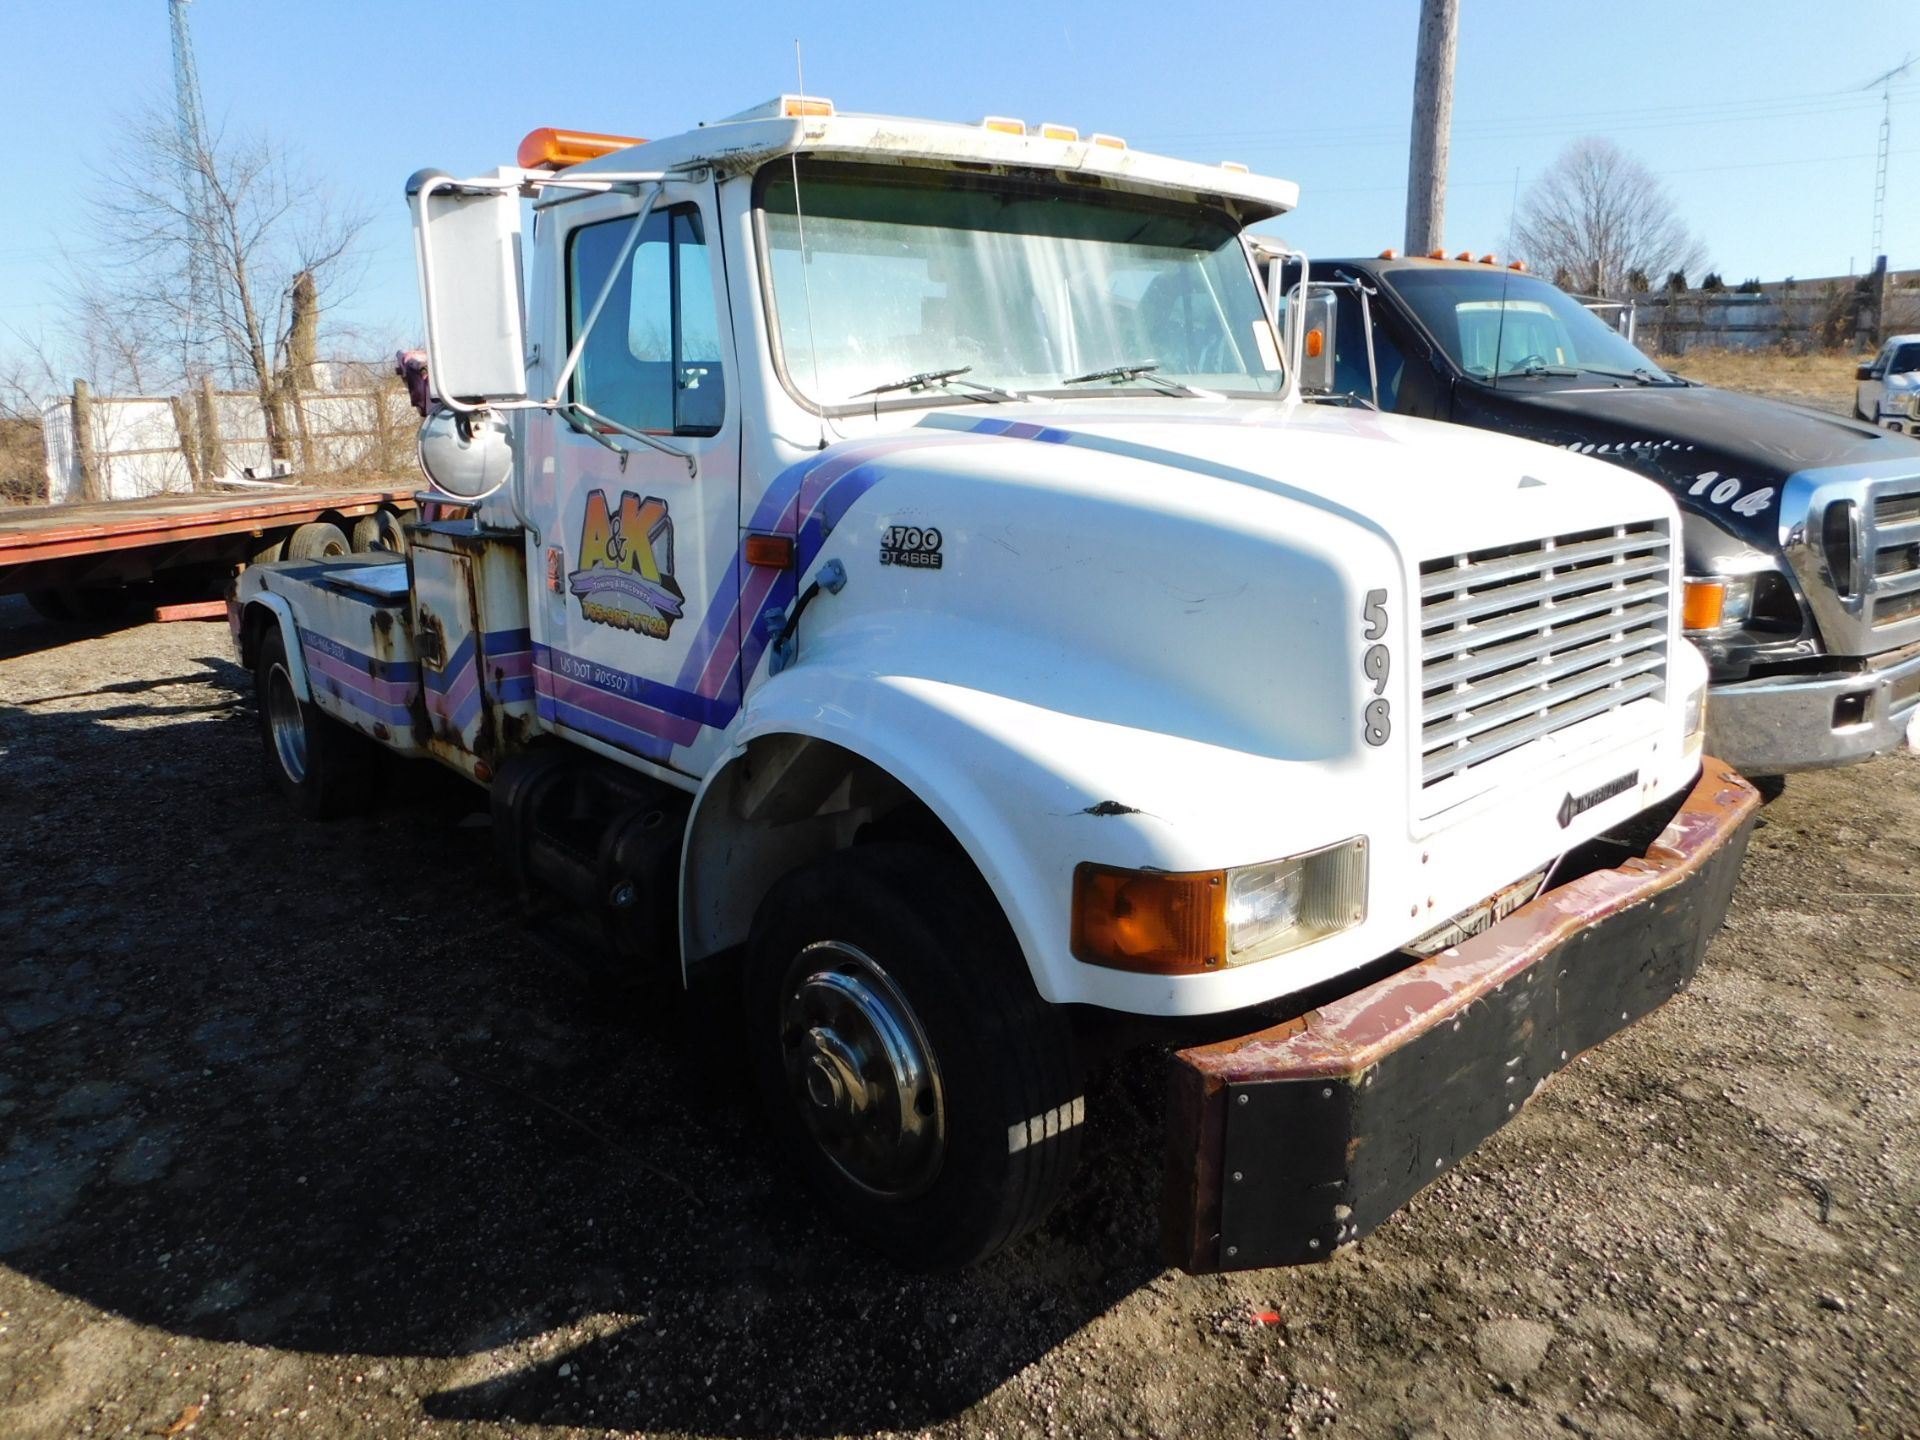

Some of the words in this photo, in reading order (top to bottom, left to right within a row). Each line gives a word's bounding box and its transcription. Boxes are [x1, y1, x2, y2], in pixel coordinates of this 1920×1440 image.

[1688, 471, 1774, 517] 104
[881, 526, 942, 551] 4700
[560, 656, 571, 673] US
[574, 660, 590, 680] DOT
[1363, 588, 1391, 747] 598
